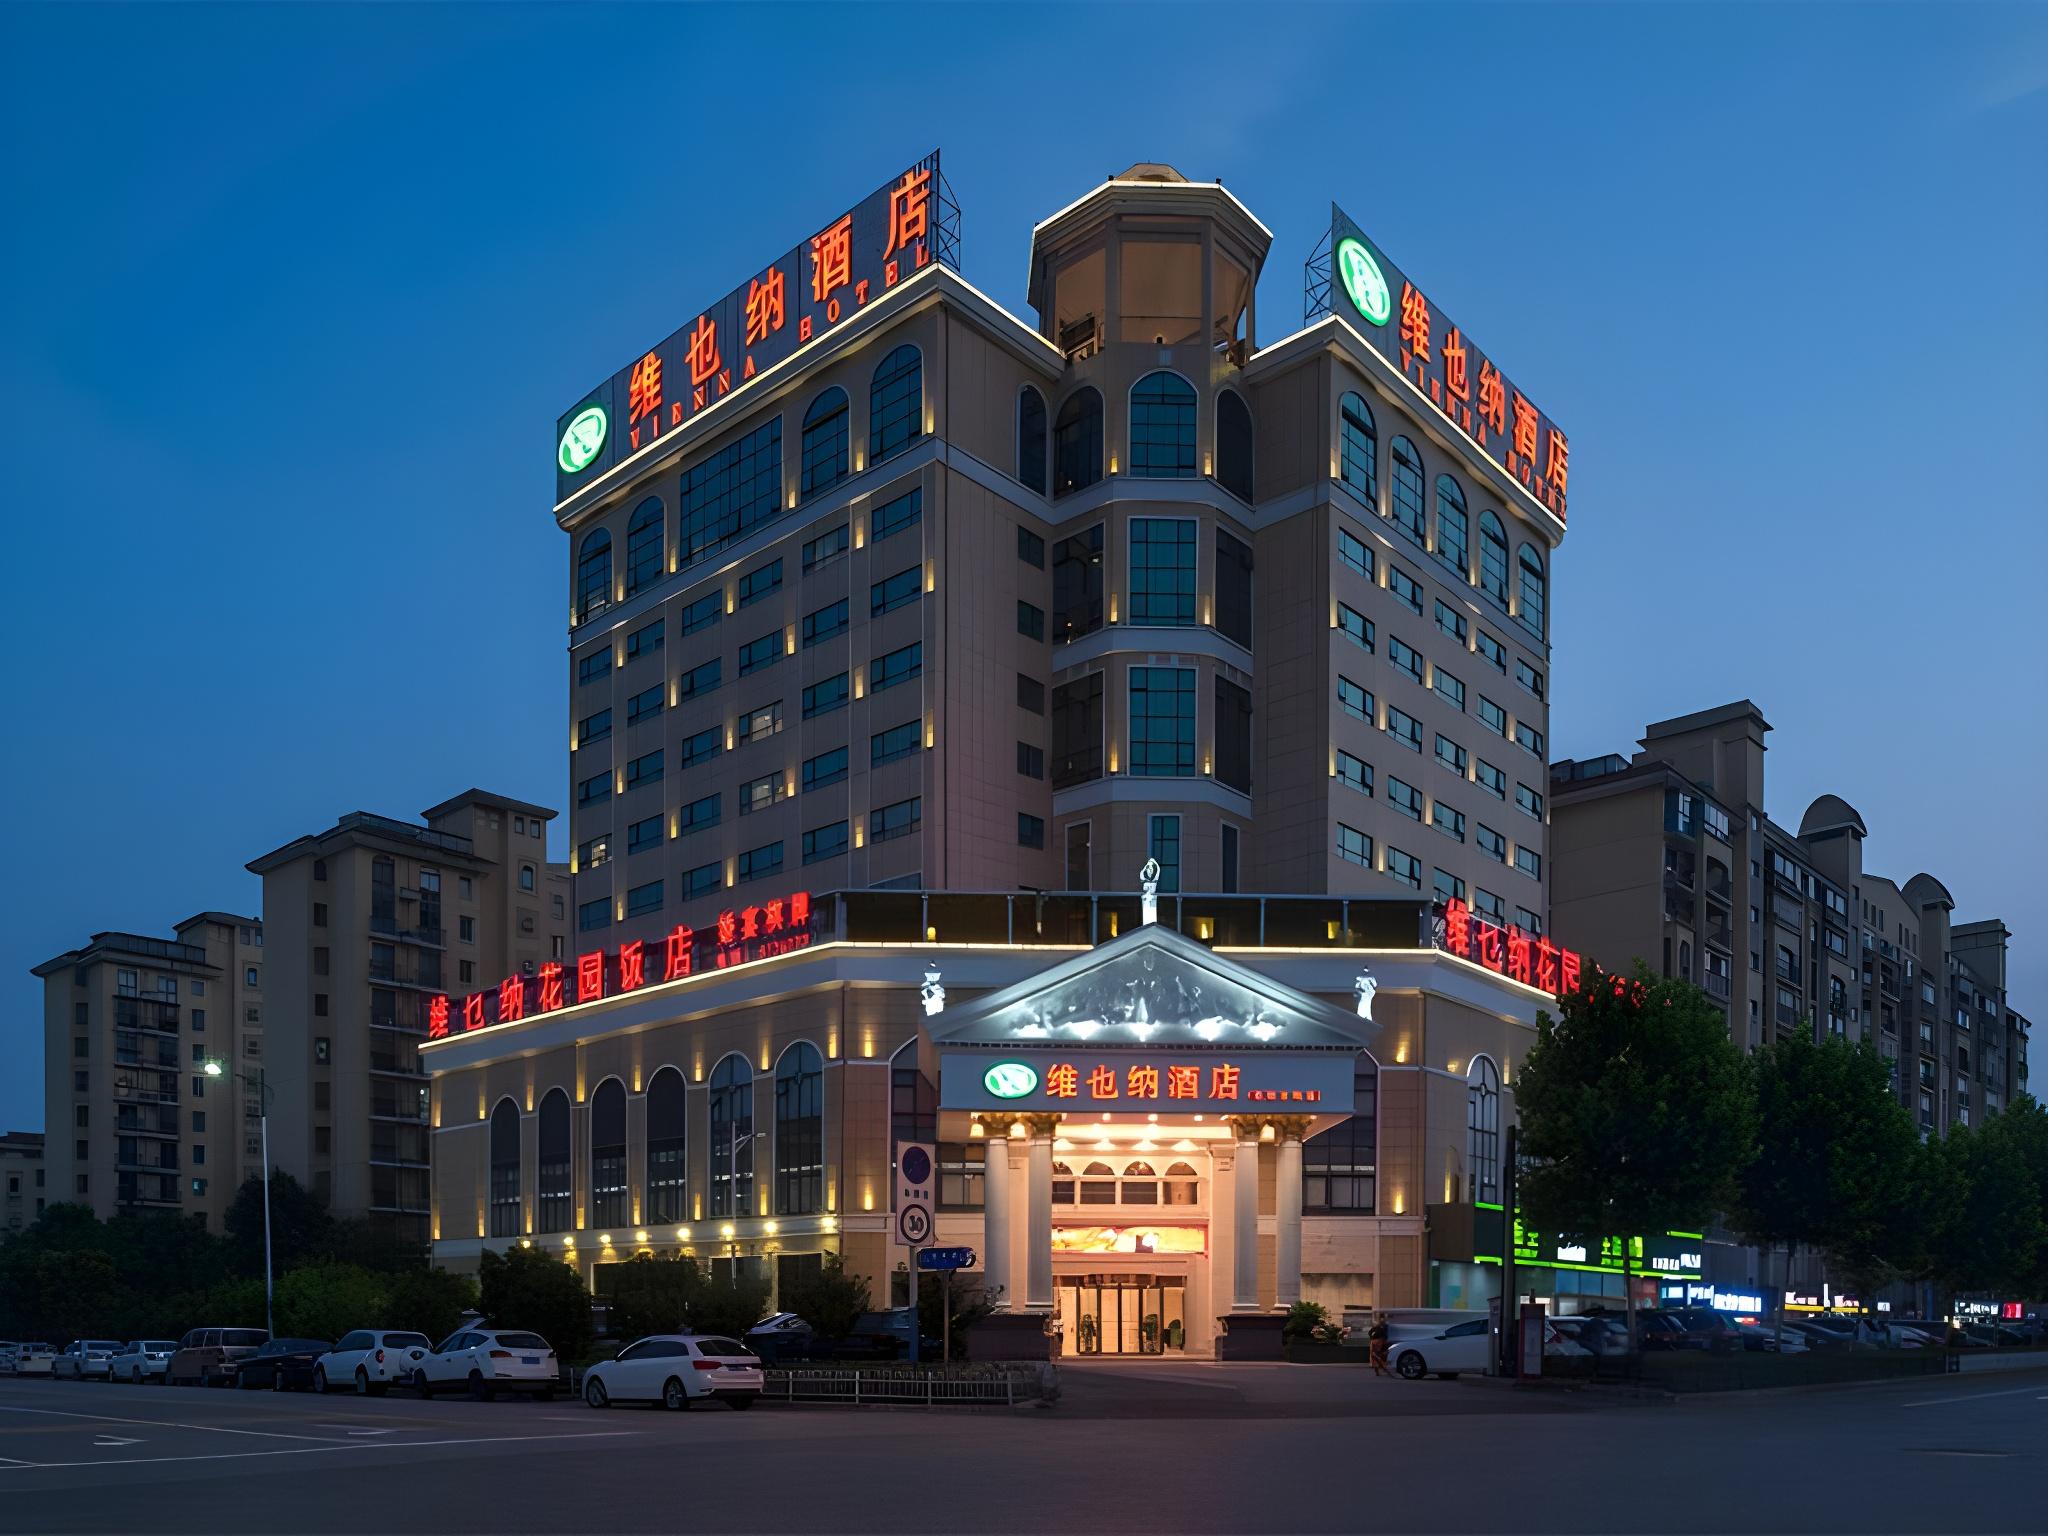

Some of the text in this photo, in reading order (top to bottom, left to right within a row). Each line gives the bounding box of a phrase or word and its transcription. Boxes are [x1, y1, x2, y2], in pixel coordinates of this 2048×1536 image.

[629, 168, 932, 424] 维也纳酒店
[1400, 281, 1568, 498] 维也纳酒店
[1046, 1063, 1241, 1100] 维也纳酒店
